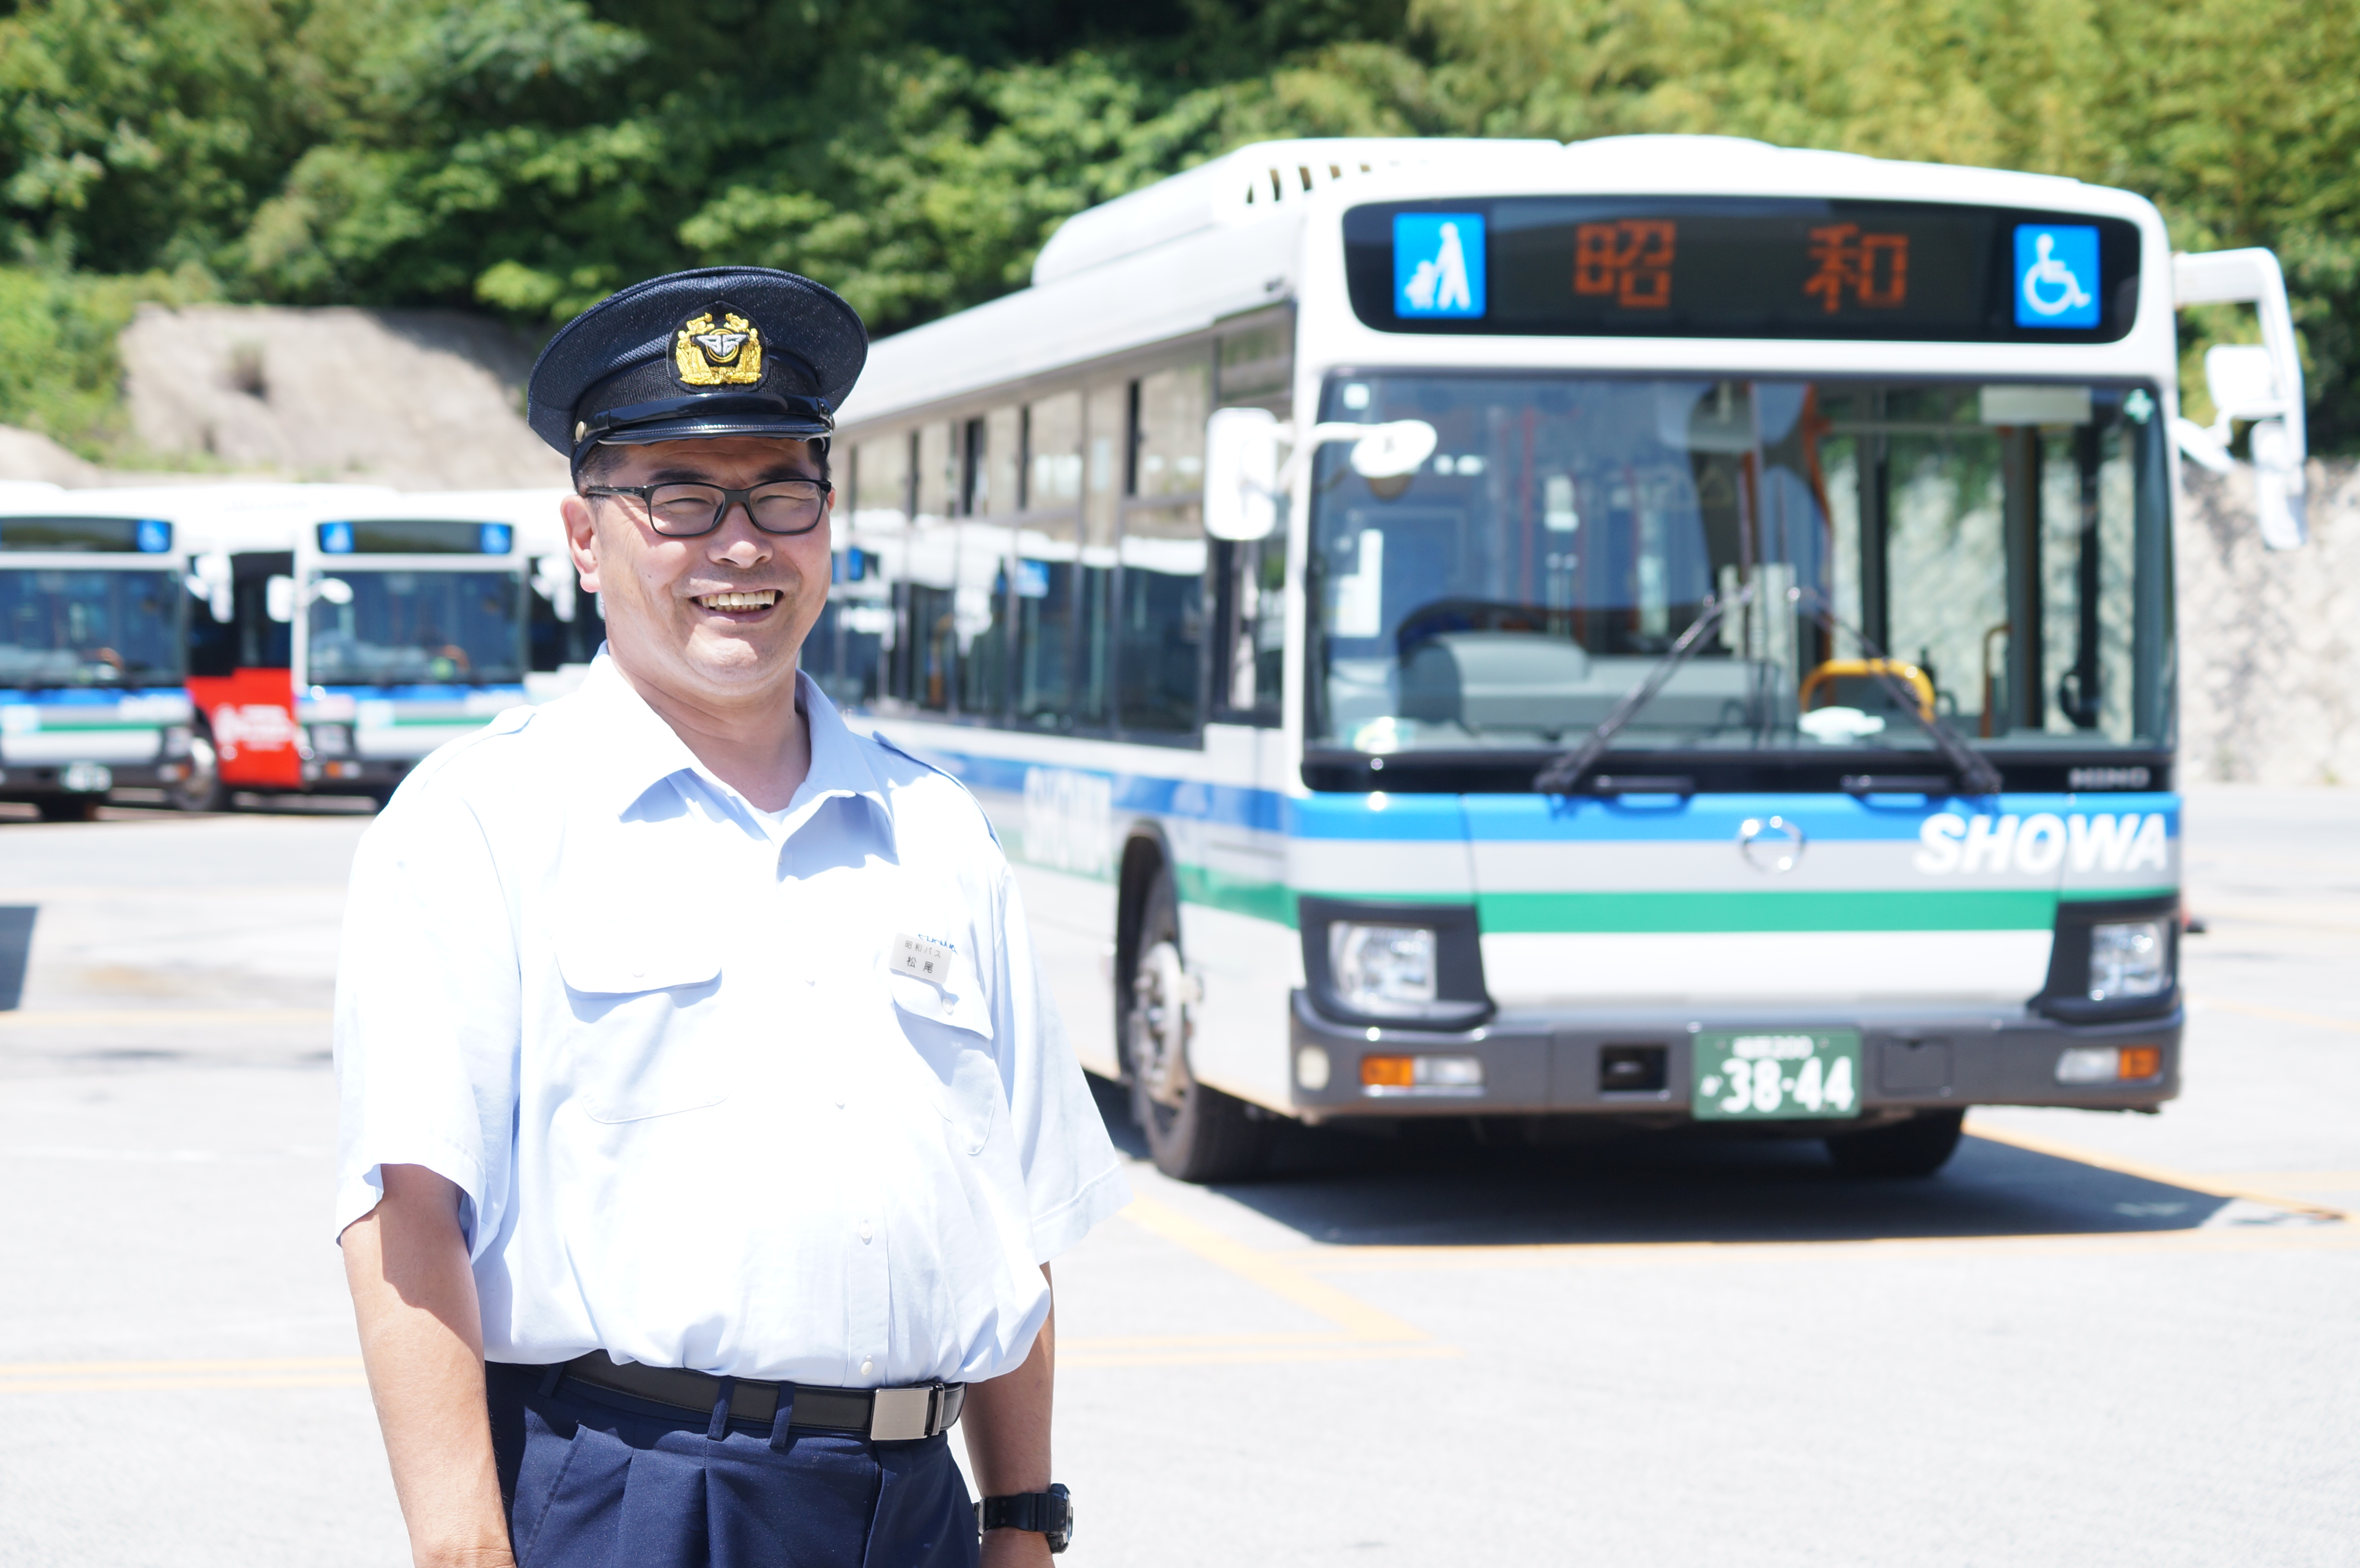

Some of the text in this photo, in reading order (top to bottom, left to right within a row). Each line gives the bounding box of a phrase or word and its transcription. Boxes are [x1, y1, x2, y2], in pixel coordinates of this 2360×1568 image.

[1914, 813, 2166, 875] SHOWA
[905, 940, 941, 958] 昭和バス
[906, 955, 934, 974] 松尾
